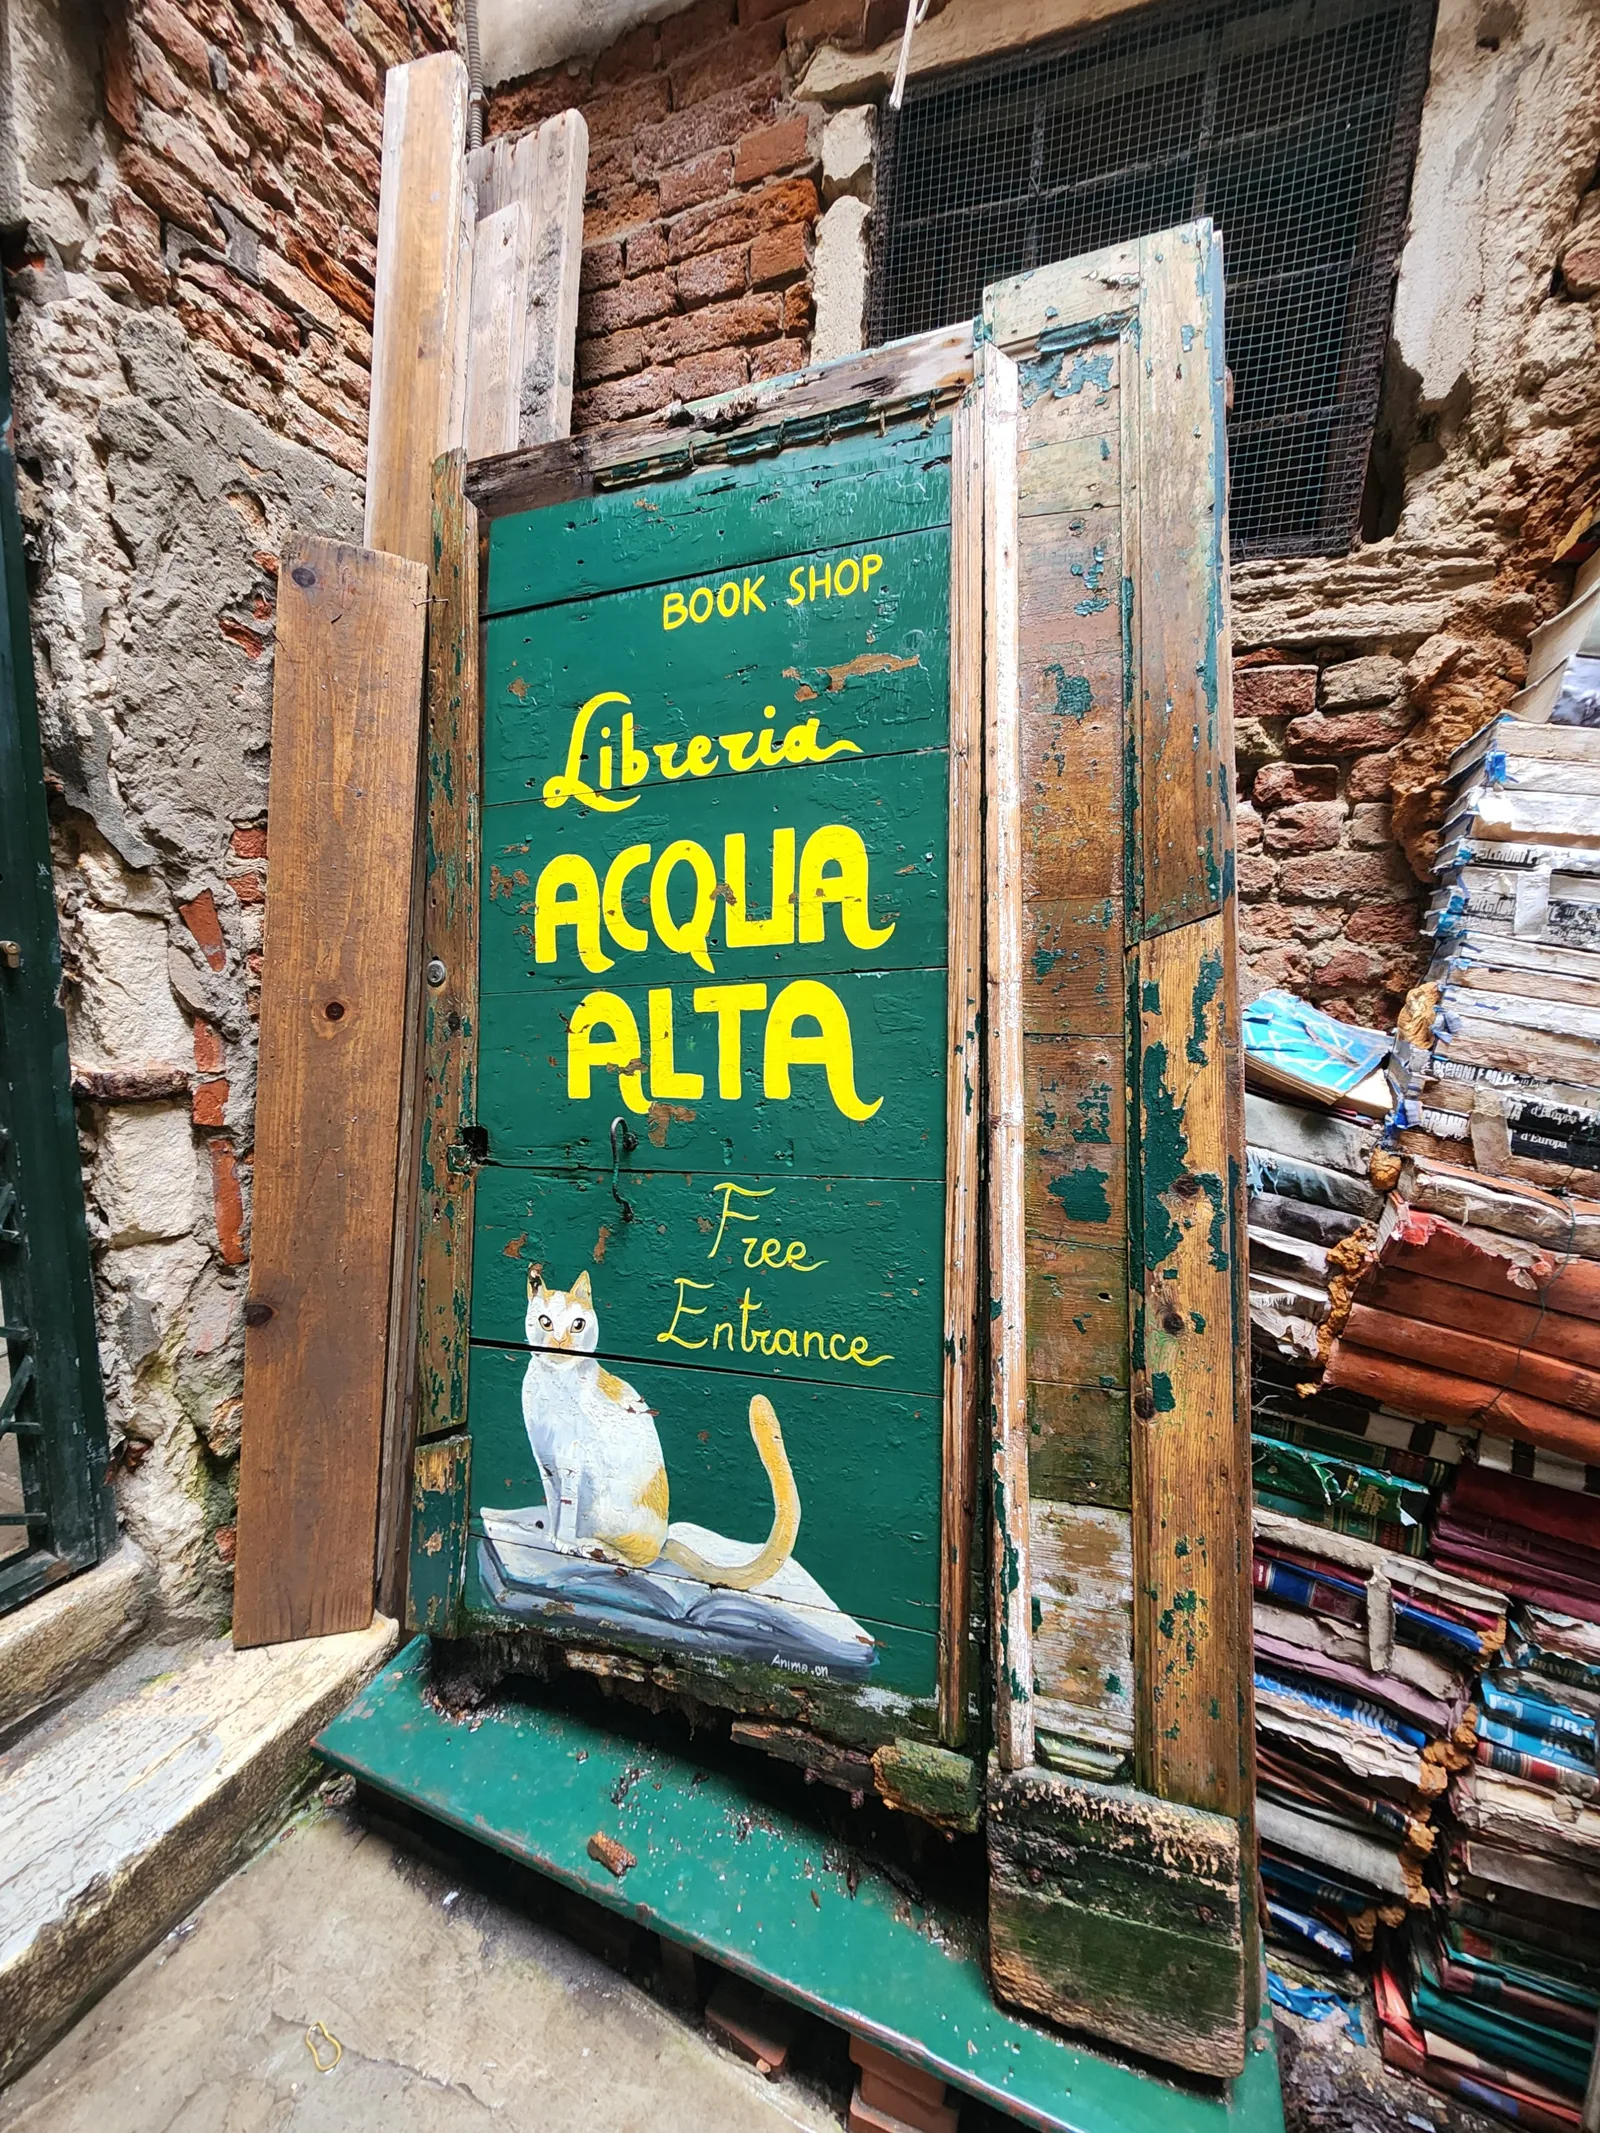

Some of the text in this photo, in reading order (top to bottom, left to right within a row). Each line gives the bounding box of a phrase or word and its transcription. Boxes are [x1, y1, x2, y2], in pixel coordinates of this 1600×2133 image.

[662, 553, 884, 631] BOOK SHOP
[542, 691, 864, 813] Libreria
[534, 824, 896, 974] ACQUA
[567, 979, 884, 1122] ALTA
[1520, 1131, 1569, 1150] d'Europa
[708, 1182, 829, 1272] Free
[656, 1277, 894, 1367] Entrance
